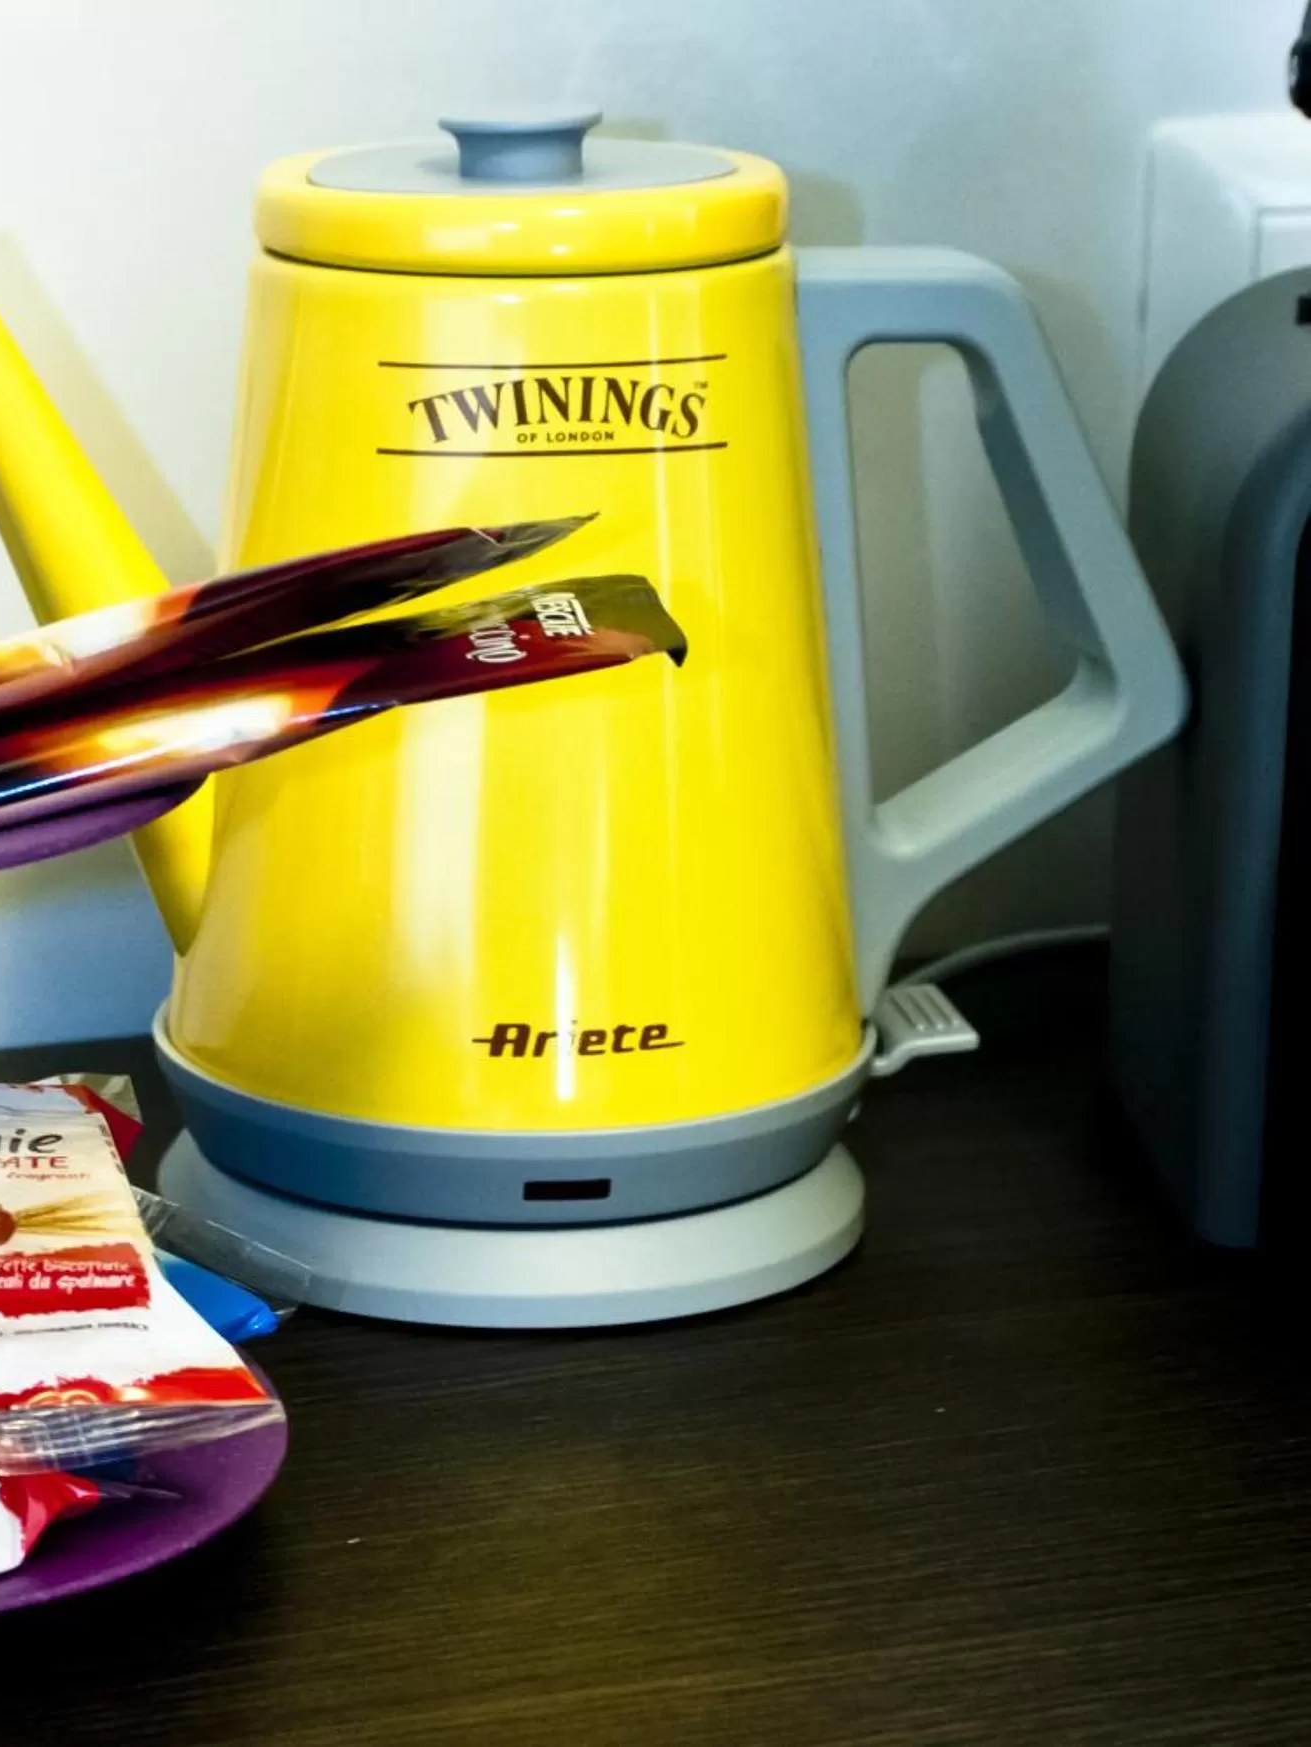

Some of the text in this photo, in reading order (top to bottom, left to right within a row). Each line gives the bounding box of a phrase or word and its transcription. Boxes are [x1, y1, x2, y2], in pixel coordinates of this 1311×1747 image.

[408, 375, 706, 444] TWININGS
[516, 430, 615, 444] OF LONDON
[471, 1019, 686, 1058] Ariete
